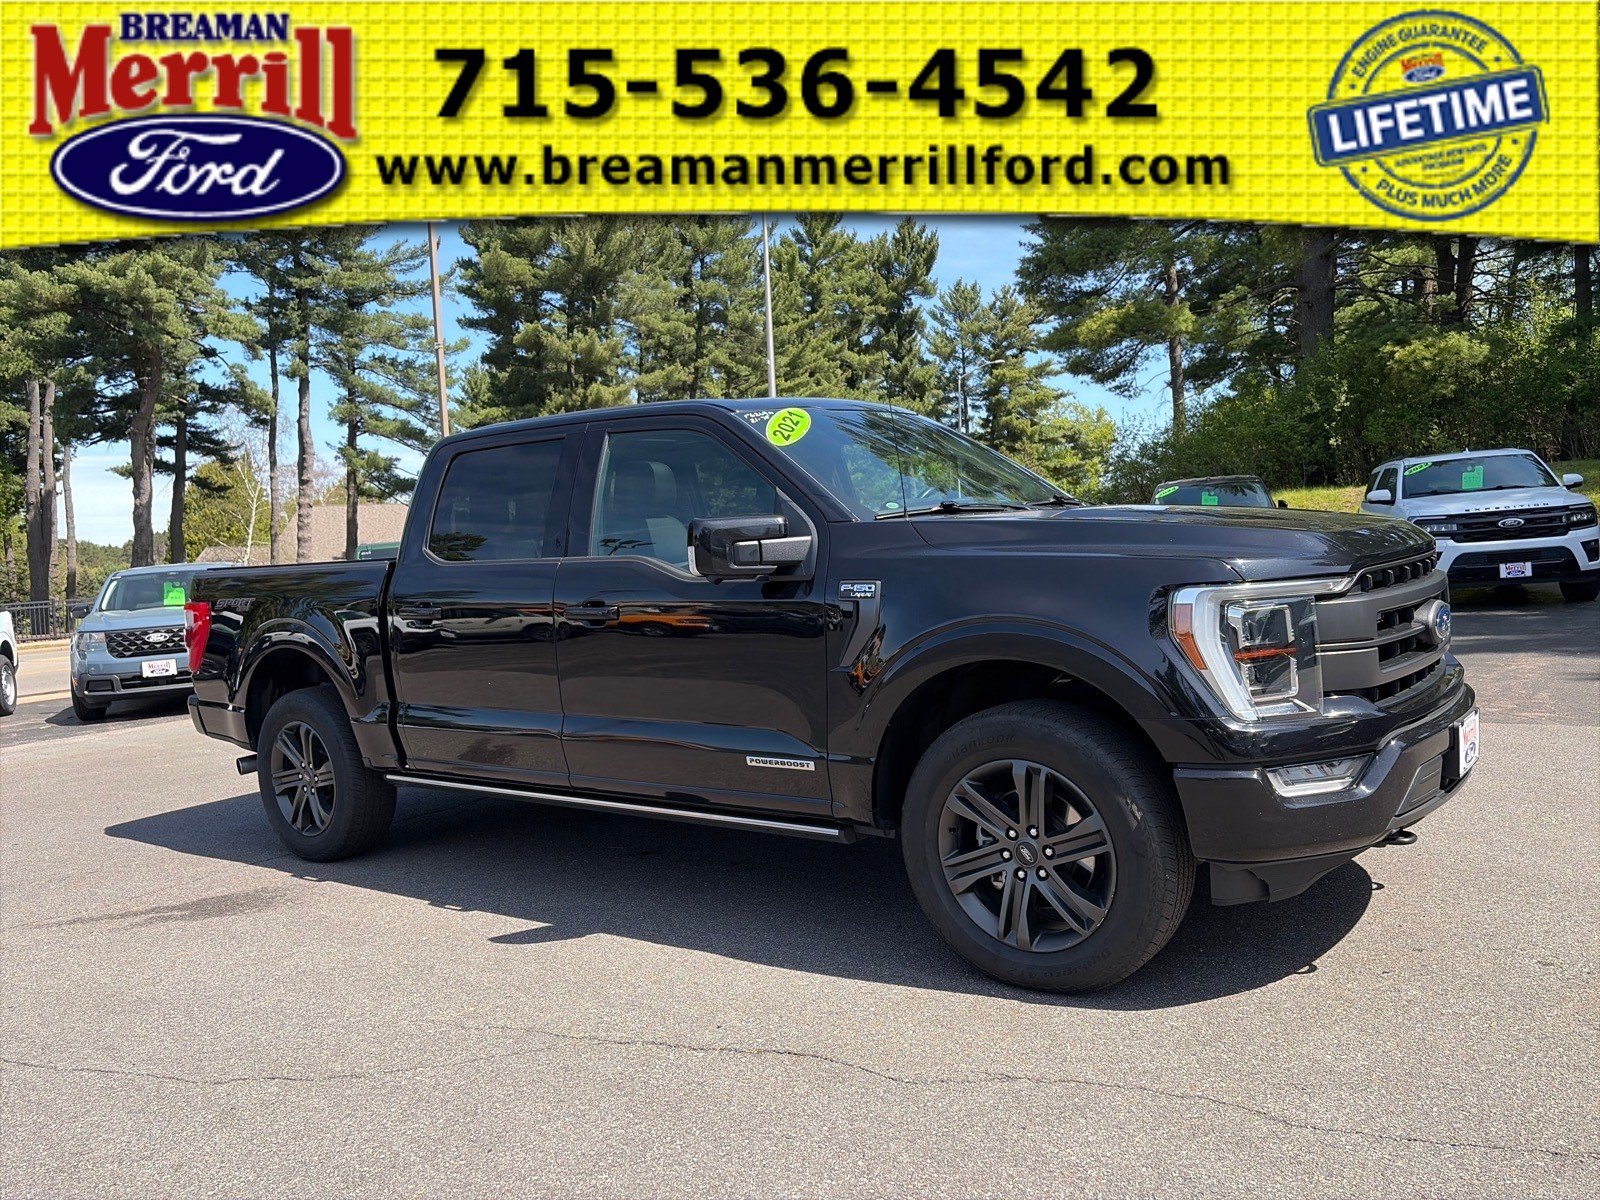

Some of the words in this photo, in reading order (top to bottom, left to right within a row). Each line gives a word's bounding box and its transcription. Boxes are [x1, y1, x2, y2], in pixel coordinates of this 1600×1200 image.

[772, 410, 804, 442] 2021
[1464, 502, 1549, 512] EXPEDITION
[748, 757, 811, 768] POWERBOOST
